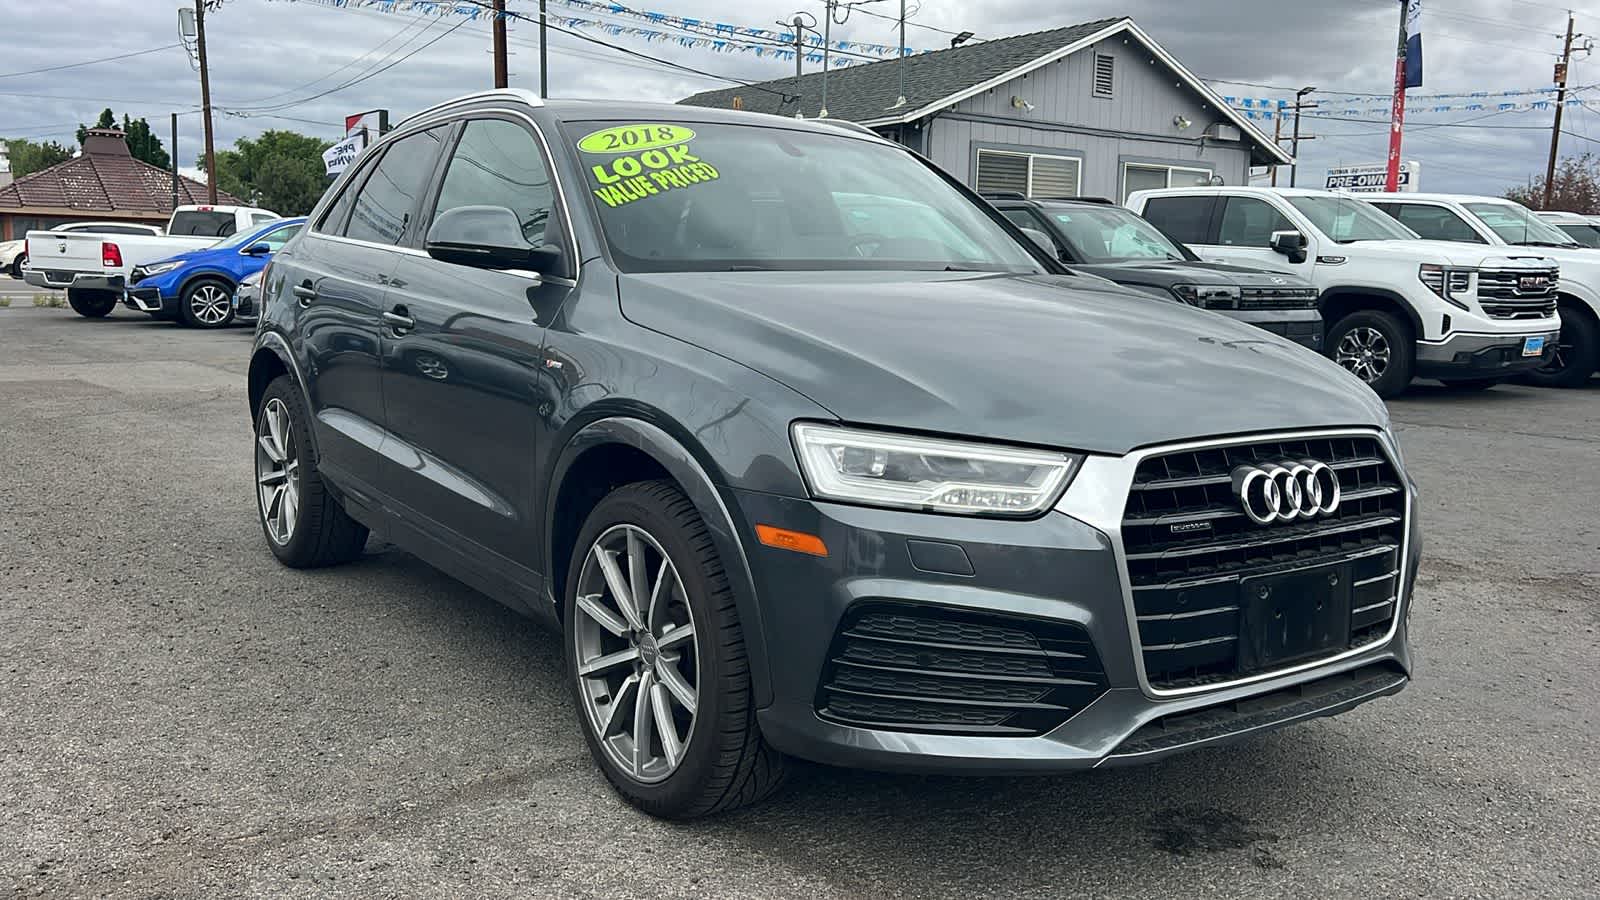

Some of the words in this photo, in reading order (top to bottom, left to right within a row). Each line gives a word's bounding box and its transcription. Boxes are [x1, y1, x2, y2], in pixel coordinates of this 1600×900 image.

[602, 127, 674, 149] 2018
[591, 144, 701, 184] LOOK
[593, 175, 660, 207] VALUE
[650, 162, 720, 190] PRICED
[1327, 173, 1406, 188] PRE-OWND
